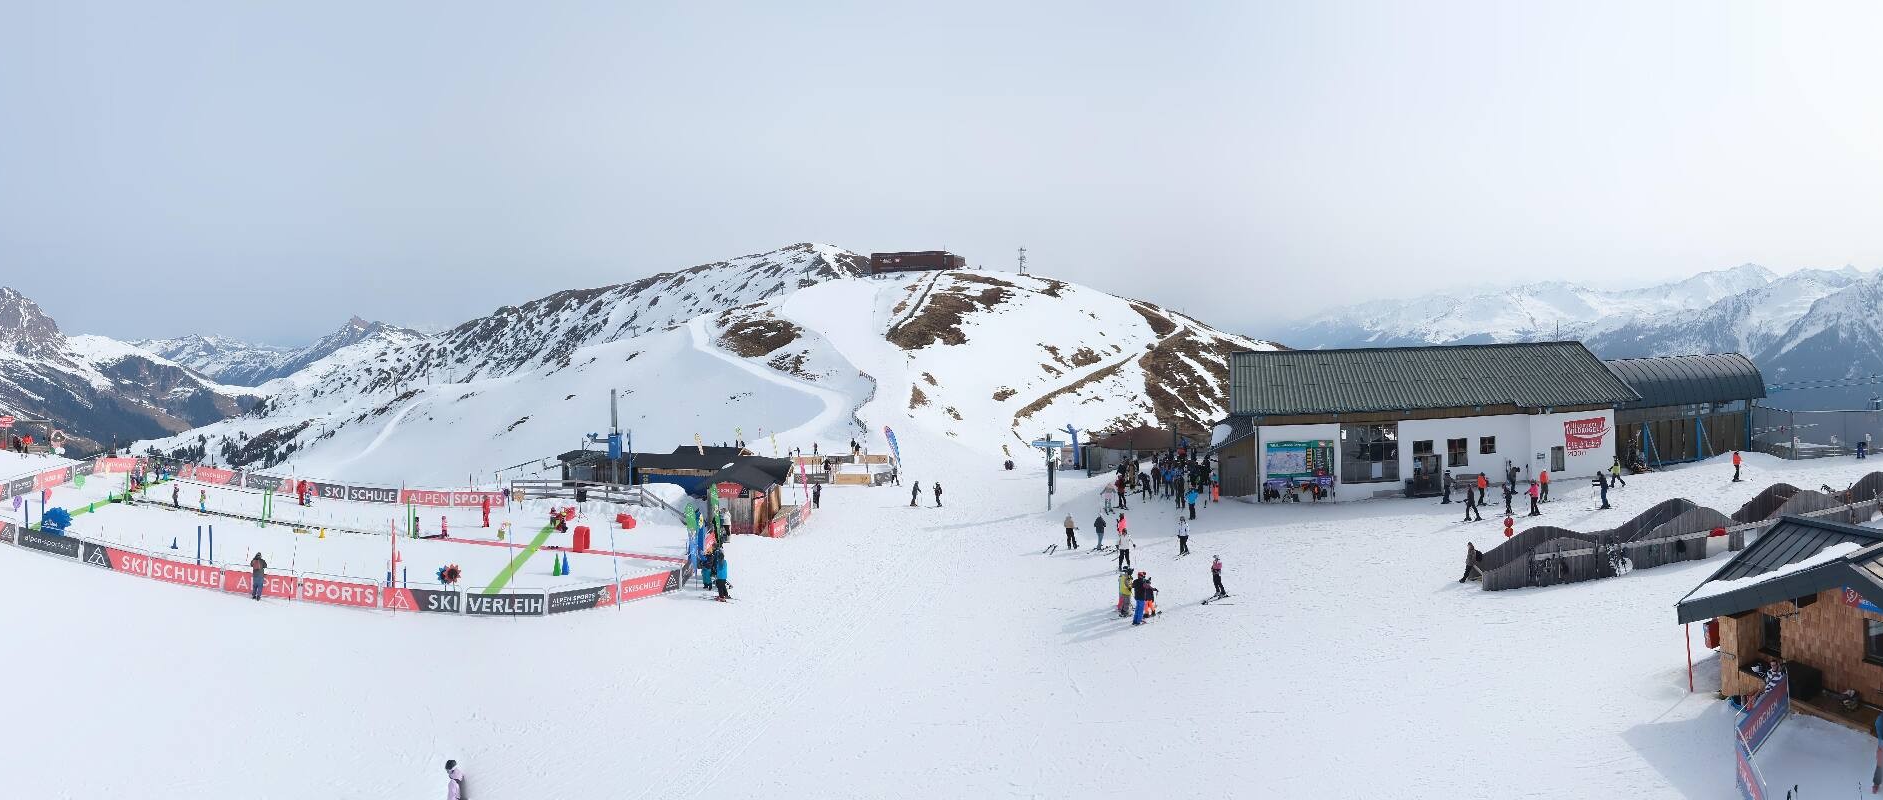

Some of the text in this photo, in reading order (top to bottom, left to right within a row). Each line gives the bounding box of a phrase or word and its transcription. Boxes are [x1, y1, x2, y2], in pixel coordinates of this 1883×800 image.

[324, 486, 395, 501] SKI SCHULE
[410, 493, 449, 504] ALPEN
[121, 555, 218, 586] SKI SCHULE
[304, 581, 374, 604] SPORTS
[428, 594, 458, 611] SKI
[469, 597, 543, 614] VERLEIH
